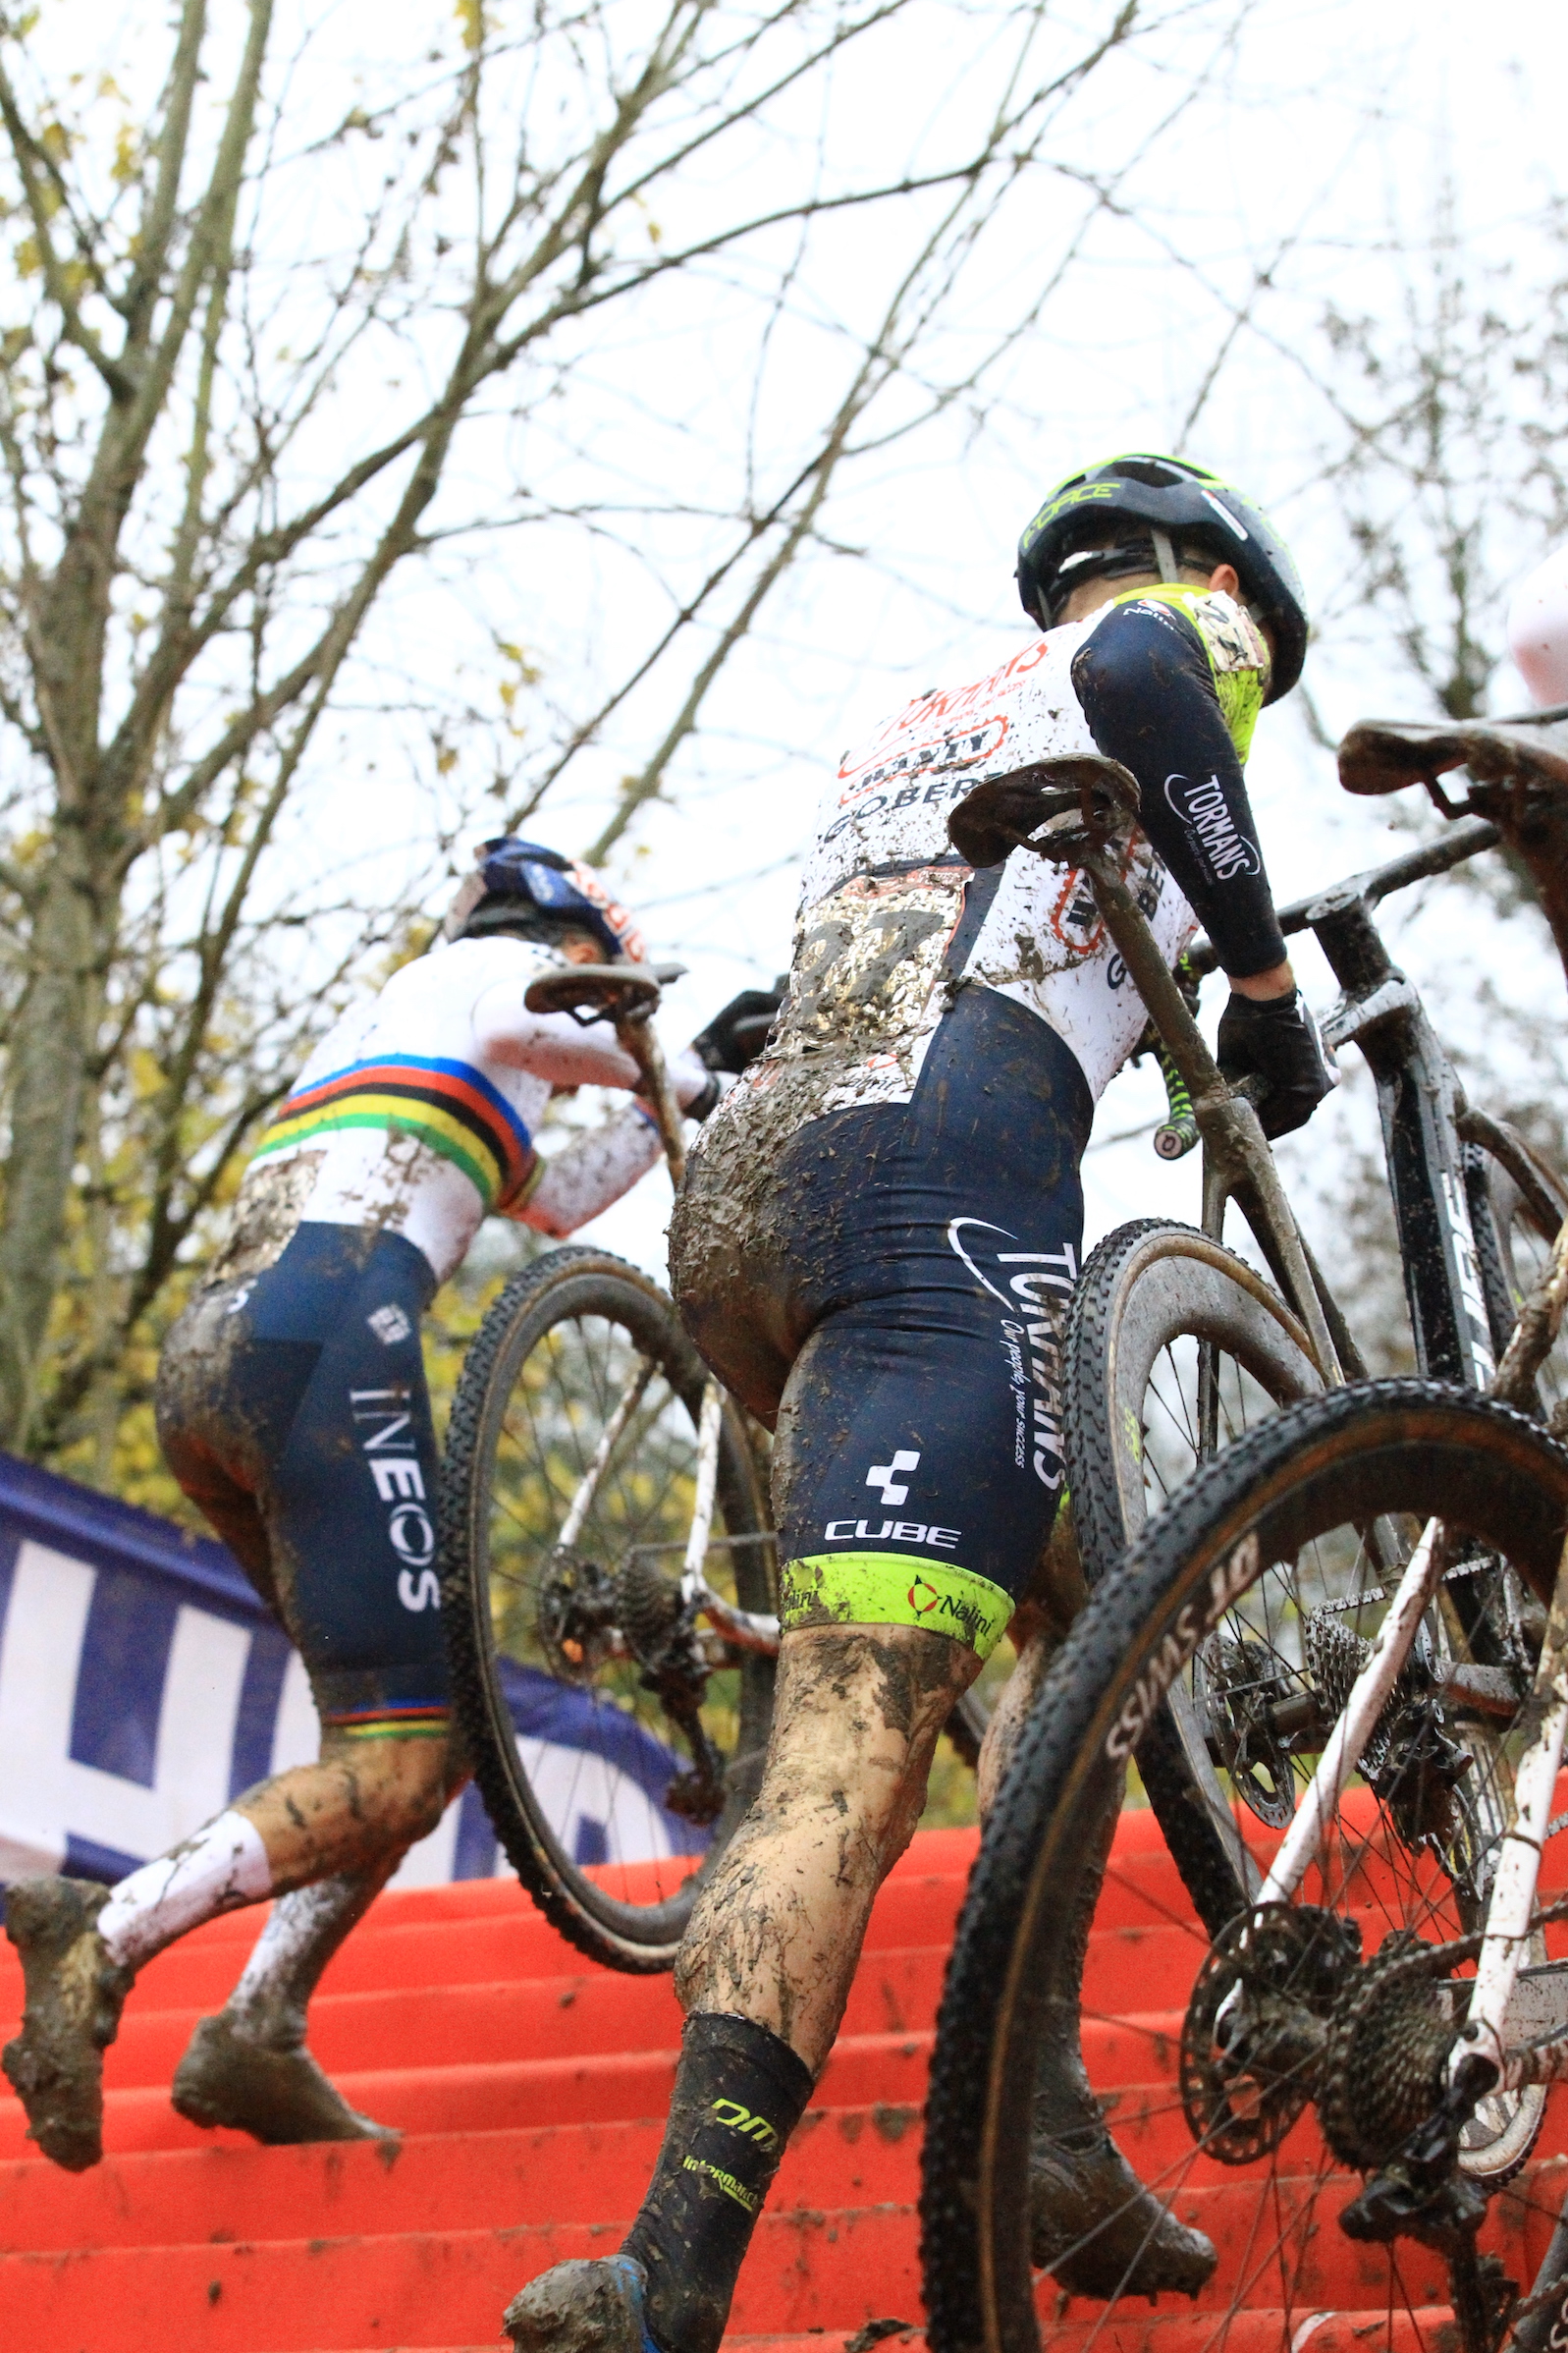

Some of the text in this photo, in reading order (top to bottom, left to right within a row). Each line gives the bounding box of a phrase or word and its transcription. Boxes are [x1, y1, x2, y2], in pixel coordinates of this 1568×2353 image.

[1184, 774, 1250, 880] TORMANS
[1000, 1319, 1025, 1344] Our
[1009, 1383, 1026, 1420] your
[1014, 1420, 1025, 1468] success
[350, 1389, 441, 1613] INEOS
[825, 1519, 962, 1549] CUBE
[940, 1594, 995, 1636] Nalini
[1107, 1605, 1197, 1759] SWISS
